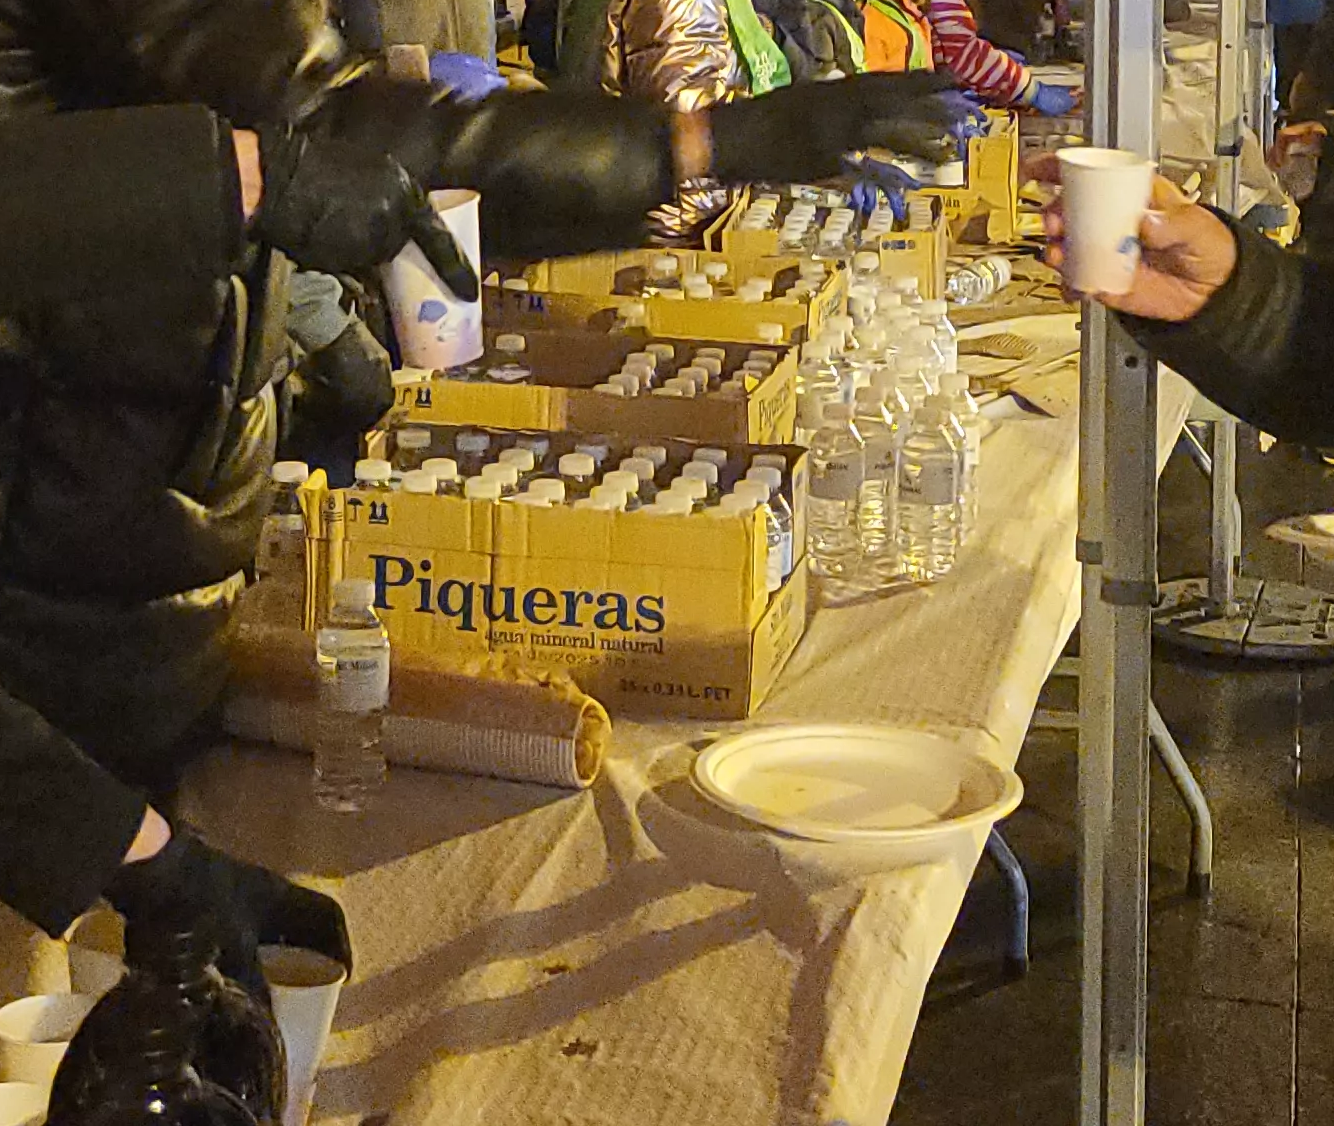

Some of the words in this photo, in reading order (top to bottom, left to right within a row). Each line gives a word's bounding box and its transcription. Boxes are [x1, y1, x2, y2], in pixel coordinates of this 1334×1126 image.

[368, 554, 666, 633] Piqueras
[530, 630, 595, 650] mineral
[599, 637, 665, 655] natural
